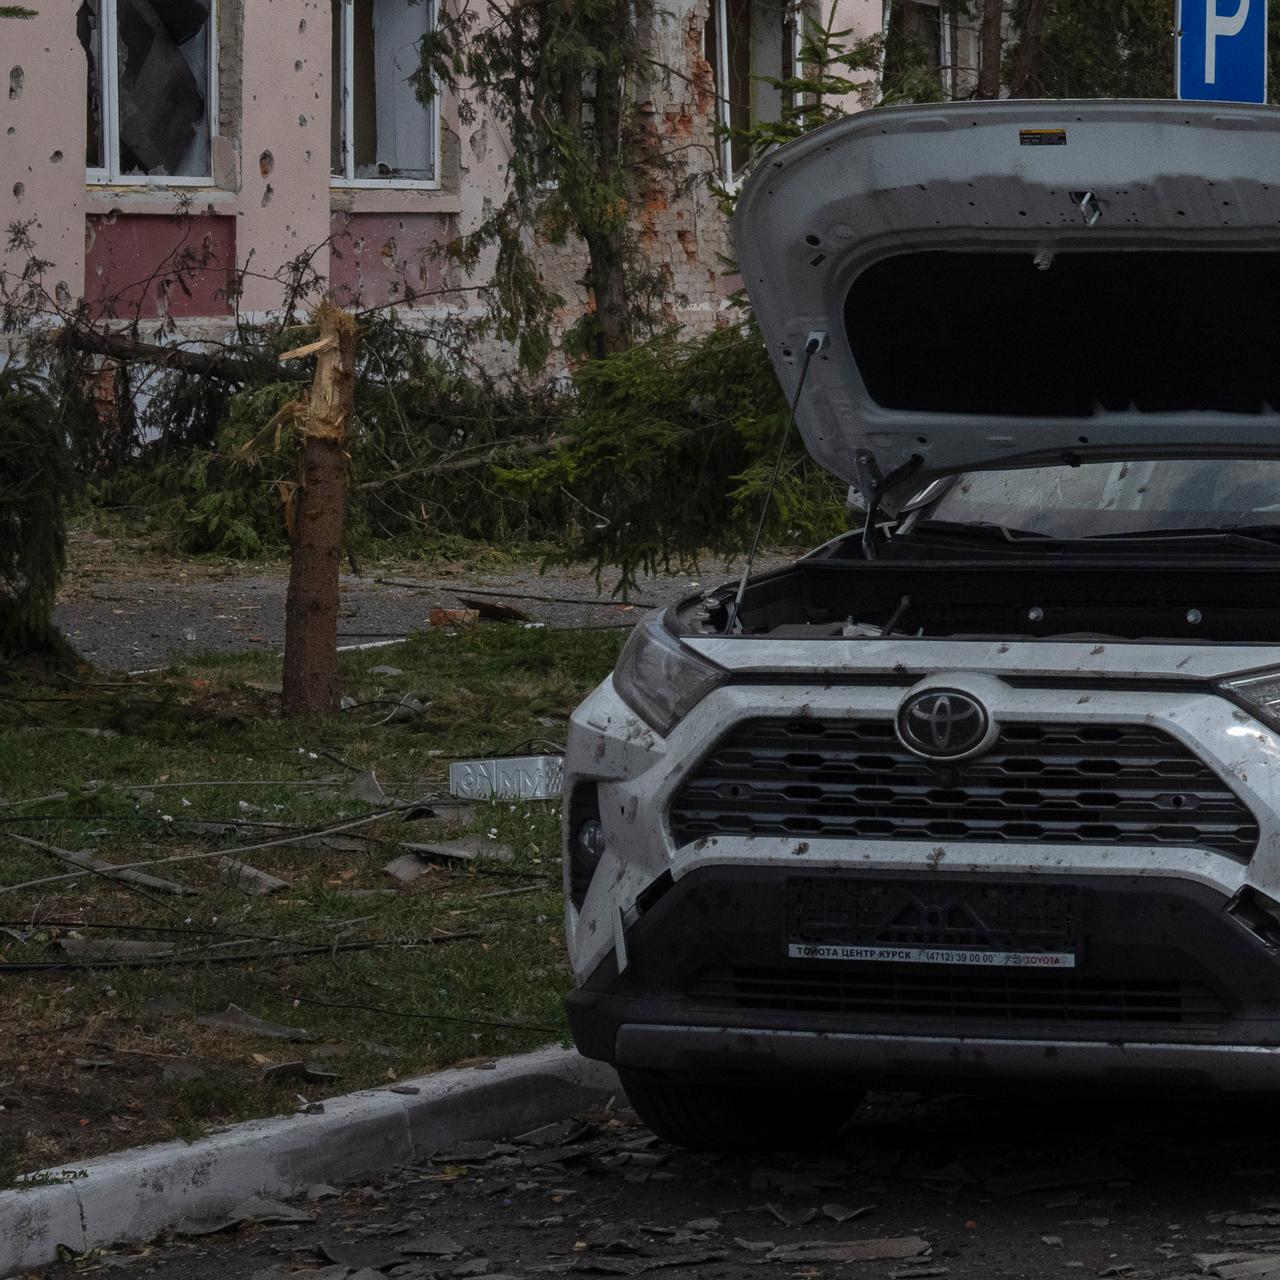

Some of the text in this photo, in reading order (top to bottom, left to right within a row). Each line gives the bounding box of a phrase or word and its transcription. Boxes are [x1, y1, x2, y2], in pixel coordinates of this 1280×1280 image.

[841, 948, 875, 959] ЦЕНТР
[879, 950, 912, 960] КУРСК
[926, 951, 954, 962] (4712)
[969, 953, 980, 963] 00
[982, 954, 994, 964] 00
[1024, 956, 1061, 965] TOYOTA
